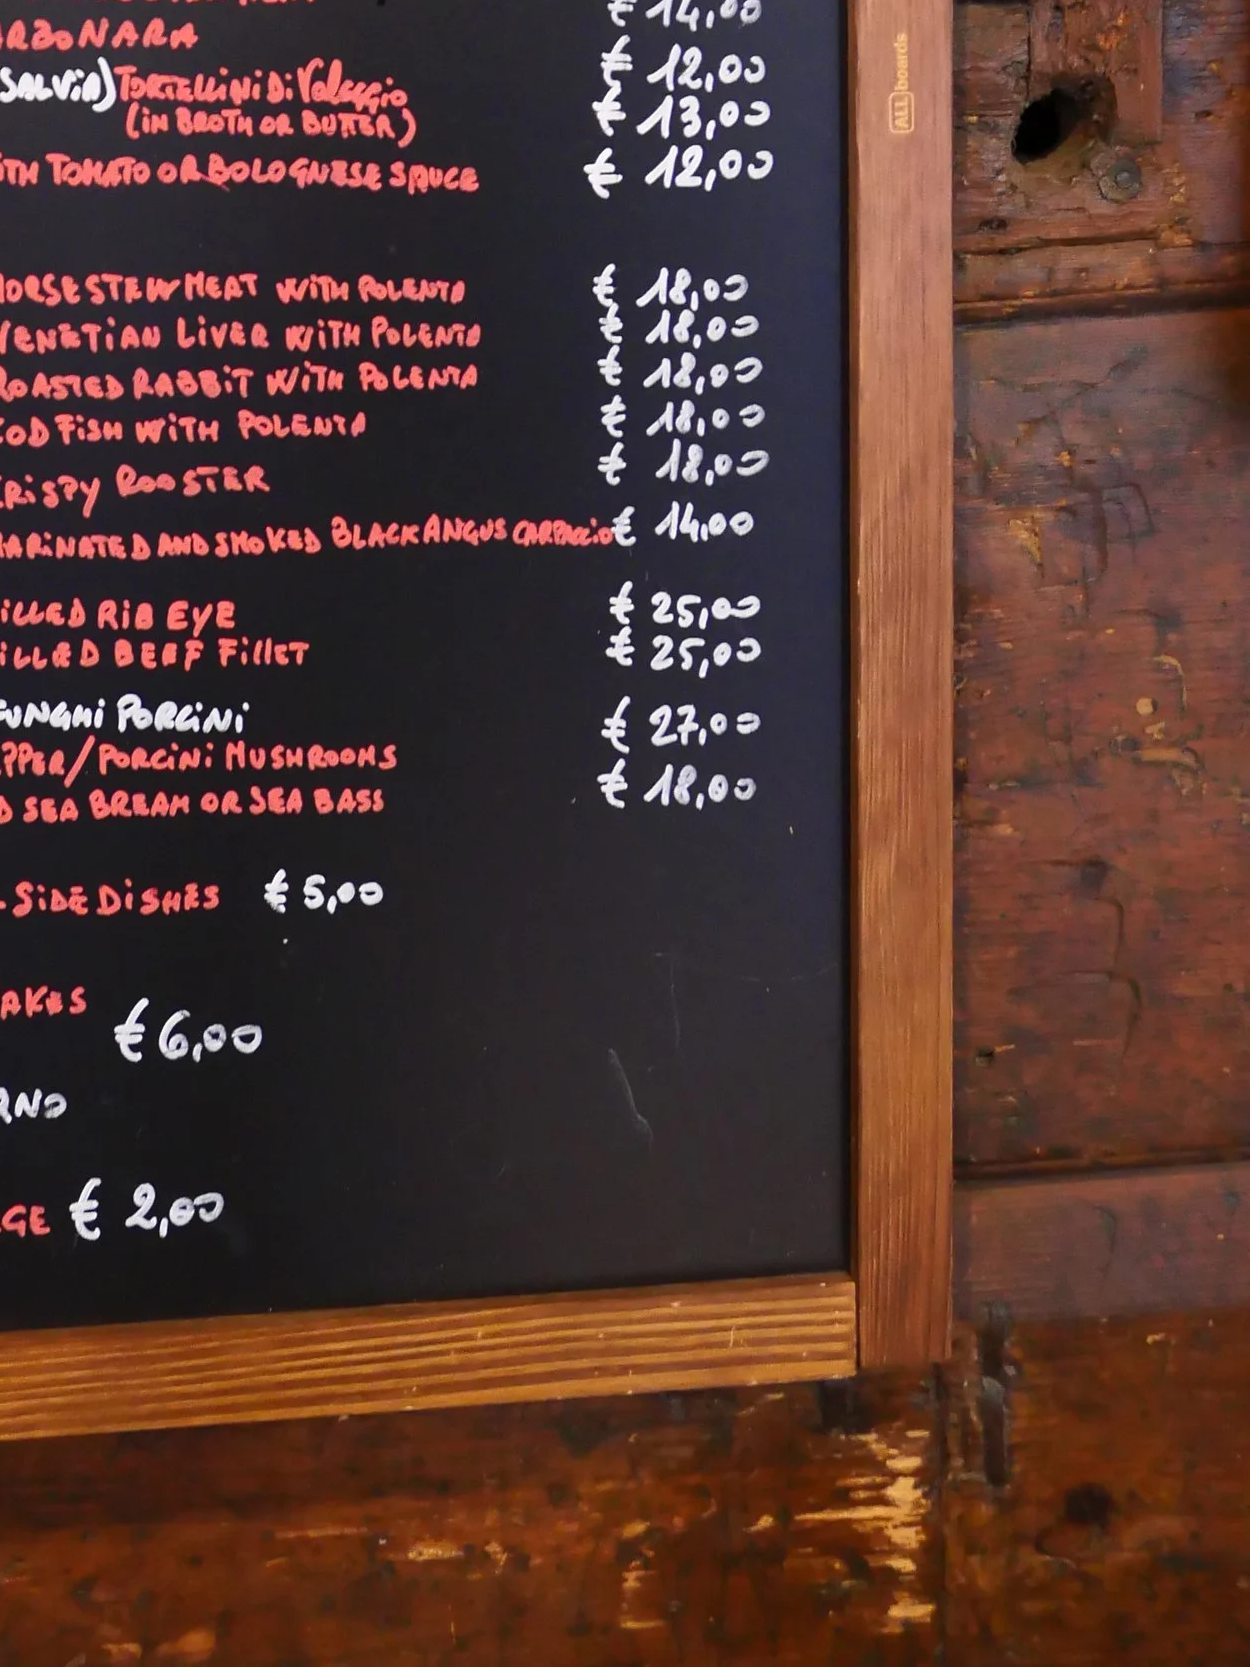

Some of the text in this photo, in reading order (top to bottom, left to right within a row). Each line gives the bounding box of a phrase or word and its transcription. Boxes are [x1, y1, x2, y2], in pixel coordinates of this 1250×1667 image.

[646, 43, 766, 93] 12,00
[636, 94, 771, 141] 13,00
[45, 152, 152, 188] TOMATO
[389, 164, 479, 195] SAUCE
[583, 144, 774, 199] € 12,00
[356, 273, 466, 304] POLENTA
[635, 266, 749, 312] 18,00
[370, 314, 482, 350] POLENTA
[645, 308, 759, 349] 18,00
[357, 360, 478, 393] POLENTA
[237, 408, 367, 440] POLENTA
[600, 394, 765, 438] € 18,00
[114, 463, 271, 498] ROOSTER
[655, 438, 769, 487] 18,00
[654, 500, 754, 543] 14,00
[165, 599, 236, 638] EYE
[609, 580, 761, 630] € 25,00
[113, 638, 204, 671] BEEF
[605, 625, 762, 679] € 25,00
[600, 695, 761, 754] € 27,00
[224, 740, 398, 771] MUSHROOMS
[22, 795, 80, 824] SEA
[88, 788, 190, 820] BREAM
[200, 789, 243, 815] OR
[249, 784, 303, 816] SEA
[312, 786, 384, 815] BASS
[643, 763, 756, 810] 18,00
[263, 868, 384, 914] € 5,00
[113, 997, 263, 1063] € 6,00
[68, 1177, 224, 1241] € 2,00
